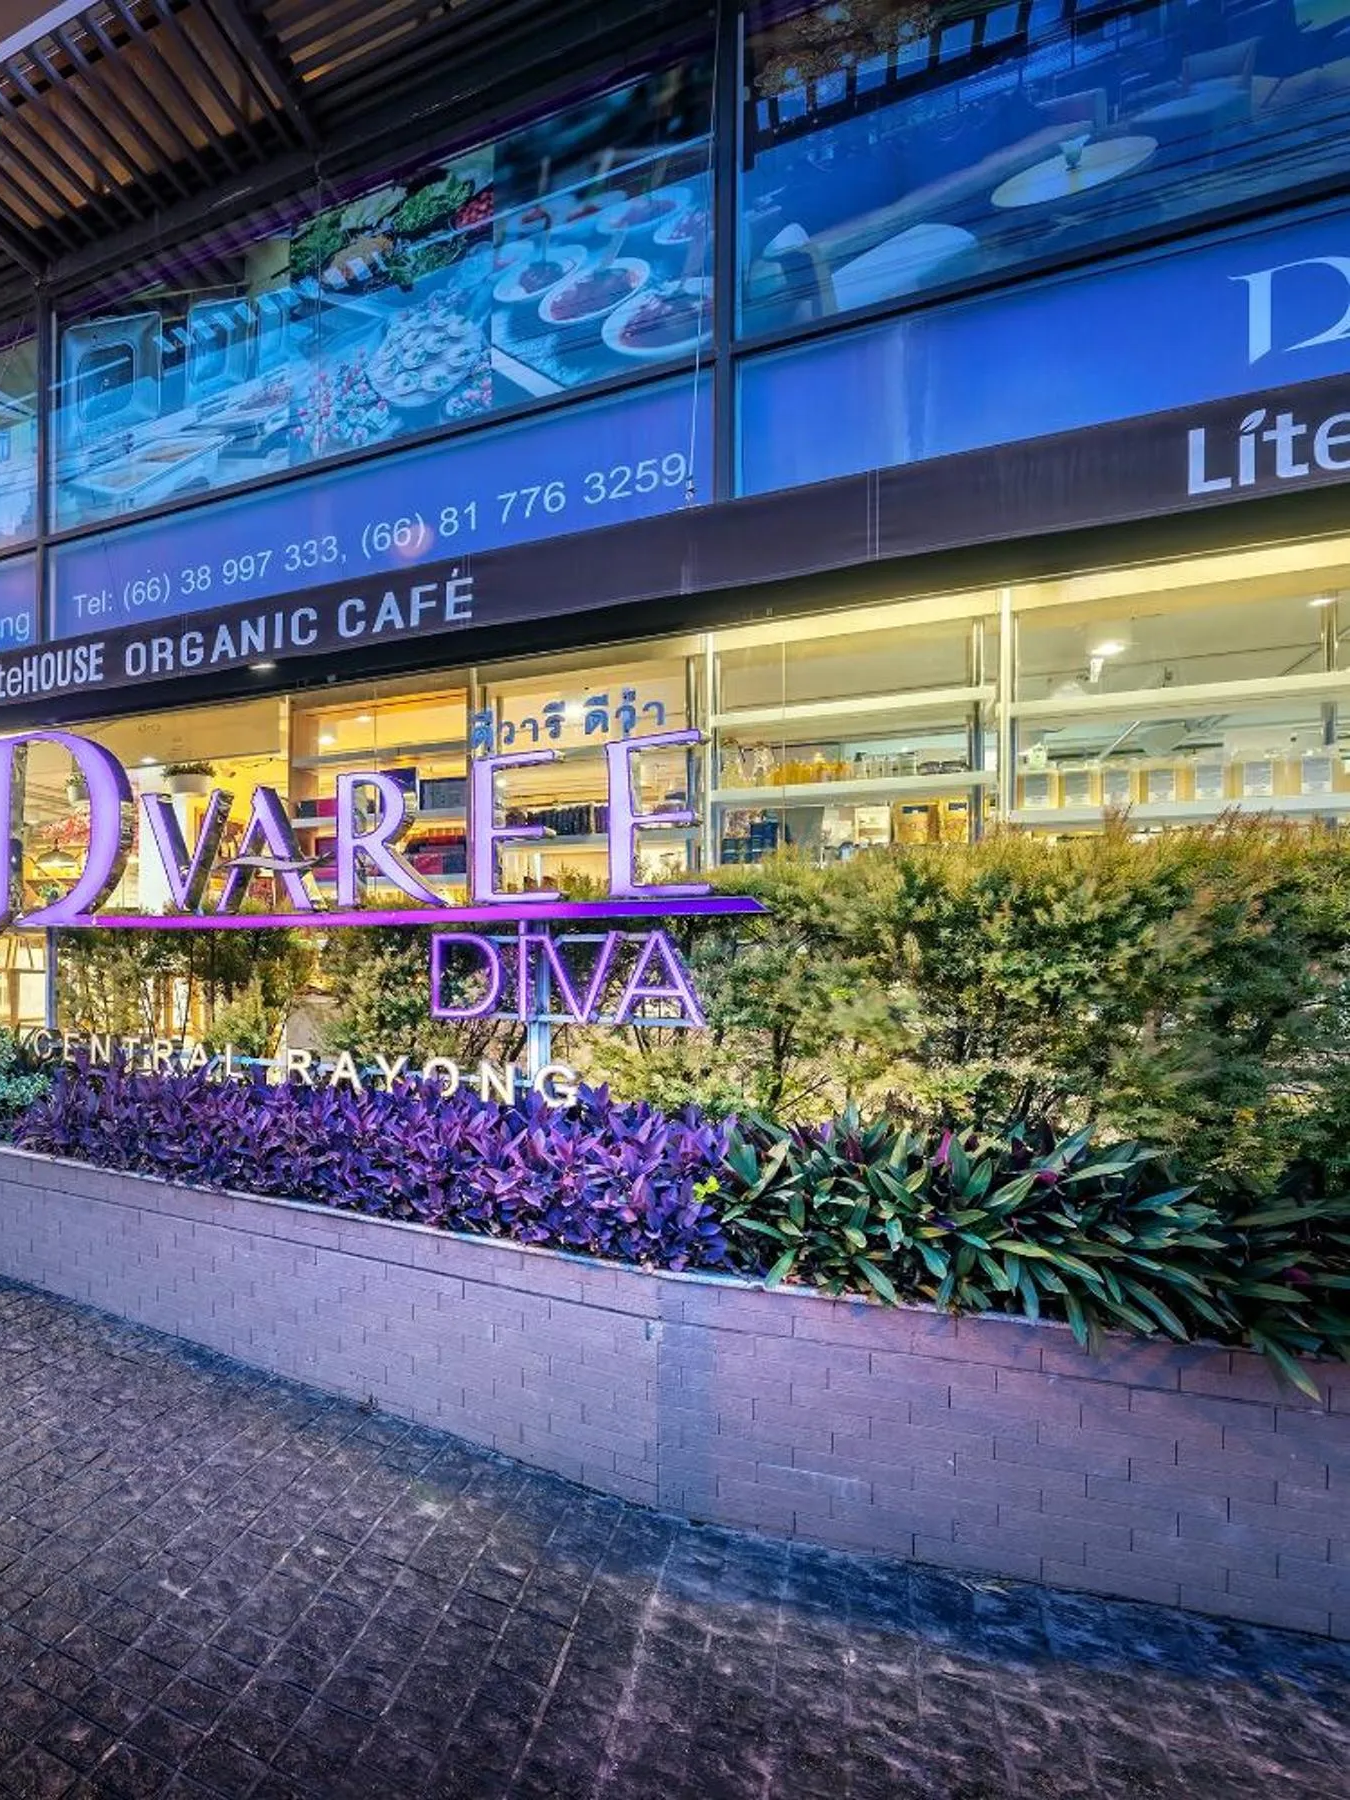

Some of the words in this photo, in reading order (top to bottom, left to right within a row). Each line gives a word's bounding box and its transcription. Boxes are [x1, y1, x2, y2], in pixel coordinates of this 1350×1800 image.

[73, 593, 113, 618] Tel:
[123, 572, 170, 611] (66)
[180, 564, 211, 595] 38
[222, 549, 273, 584] 997
[284, 535, 347, 572] 333,
[362, 513, 426, 560] (66)
[439, 501, 478, 537] 81
[497, 481, 566, 524] 776
[583, 452, 687, 505] 3259
[124, 606, 320, 678] ORGANIC
[337, 568, 474, 638] CAFÉ
[33, 1028, 247, 1082] CENTRAL
[286, 1047, 579, 1108] RAYONG
